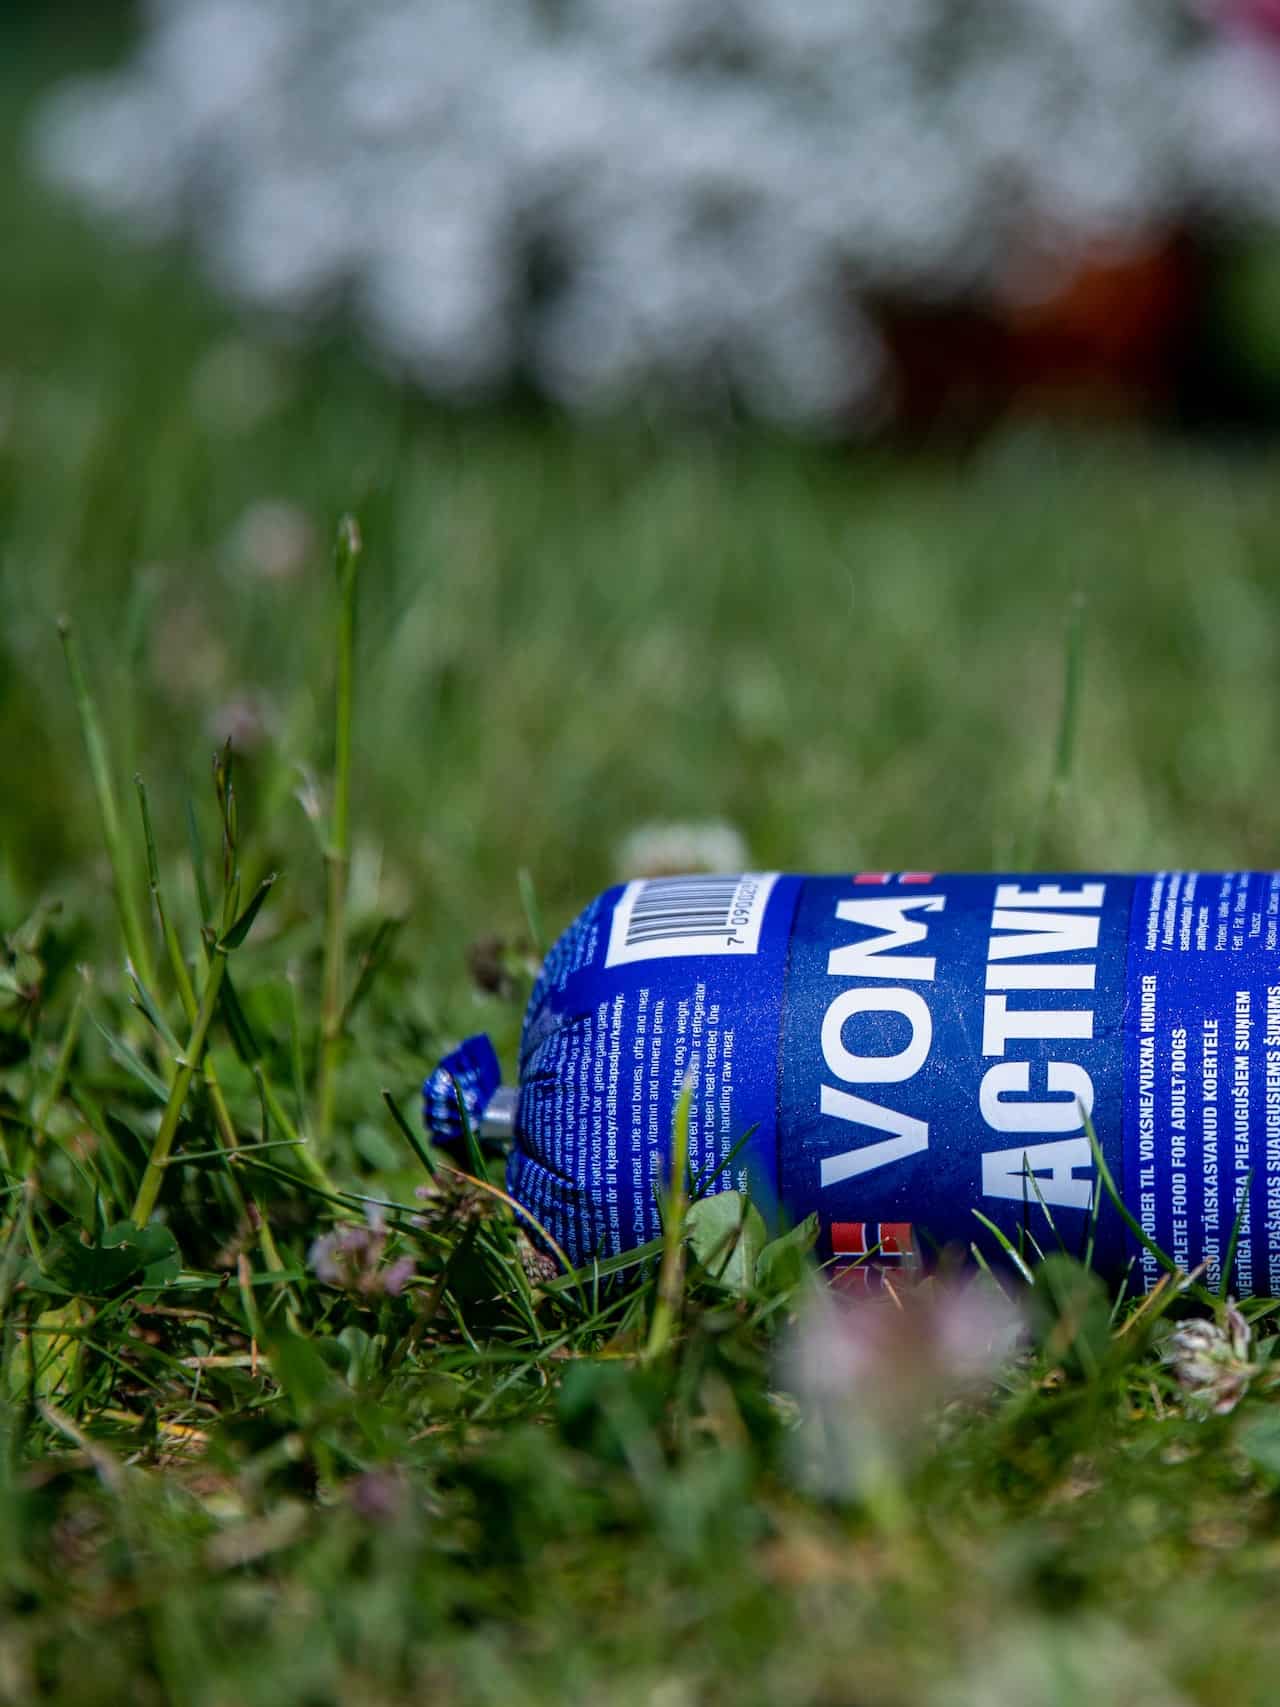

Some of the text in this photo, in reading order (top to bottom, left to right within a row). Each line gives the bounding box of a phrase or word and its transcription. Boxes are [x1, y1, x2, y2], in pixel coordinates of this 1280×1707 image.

[637, 988, 650, 1012] meat
[707, 1005, 720, 1024] One
[1140, 976, 1157, 1033] HUNDER
[634, 1015, 646, 1034] and
[820, 894, 947, 1187] VOM
[979, 882, 1107, 1211] ACTIVE
[1171, 1028, 1187, 1073] DOGS
[721, 1062, 733, 1082] raw
[1203, 1020, 1219, 1101] KOERTELE
[648, 1079, 660, 1100] and
[671, 1068, 683, 1086] the
[719, 1086, 734, 1132] handling
[1139, 1036, 1155, 1161] VOKSNE/VUXNA
[1171, 1077, 1187, 1131] ADULT
[1230, 1056, 1250, 1170] PIEAUGUŠIEM
[632, 1107, 642, 1125] and
[647, 1103, 660, 1144] Vitamin
[702, 1101, 715, 1128] been
[703, 1132, 714, 1148] not
[1171, 1136, 1187, 1167] FOR
[605, 1173, 617, 1184] til
[1140, 1165, 1156, 1188] TIL
[1172, 1173, 1187, 1215] FOOD
